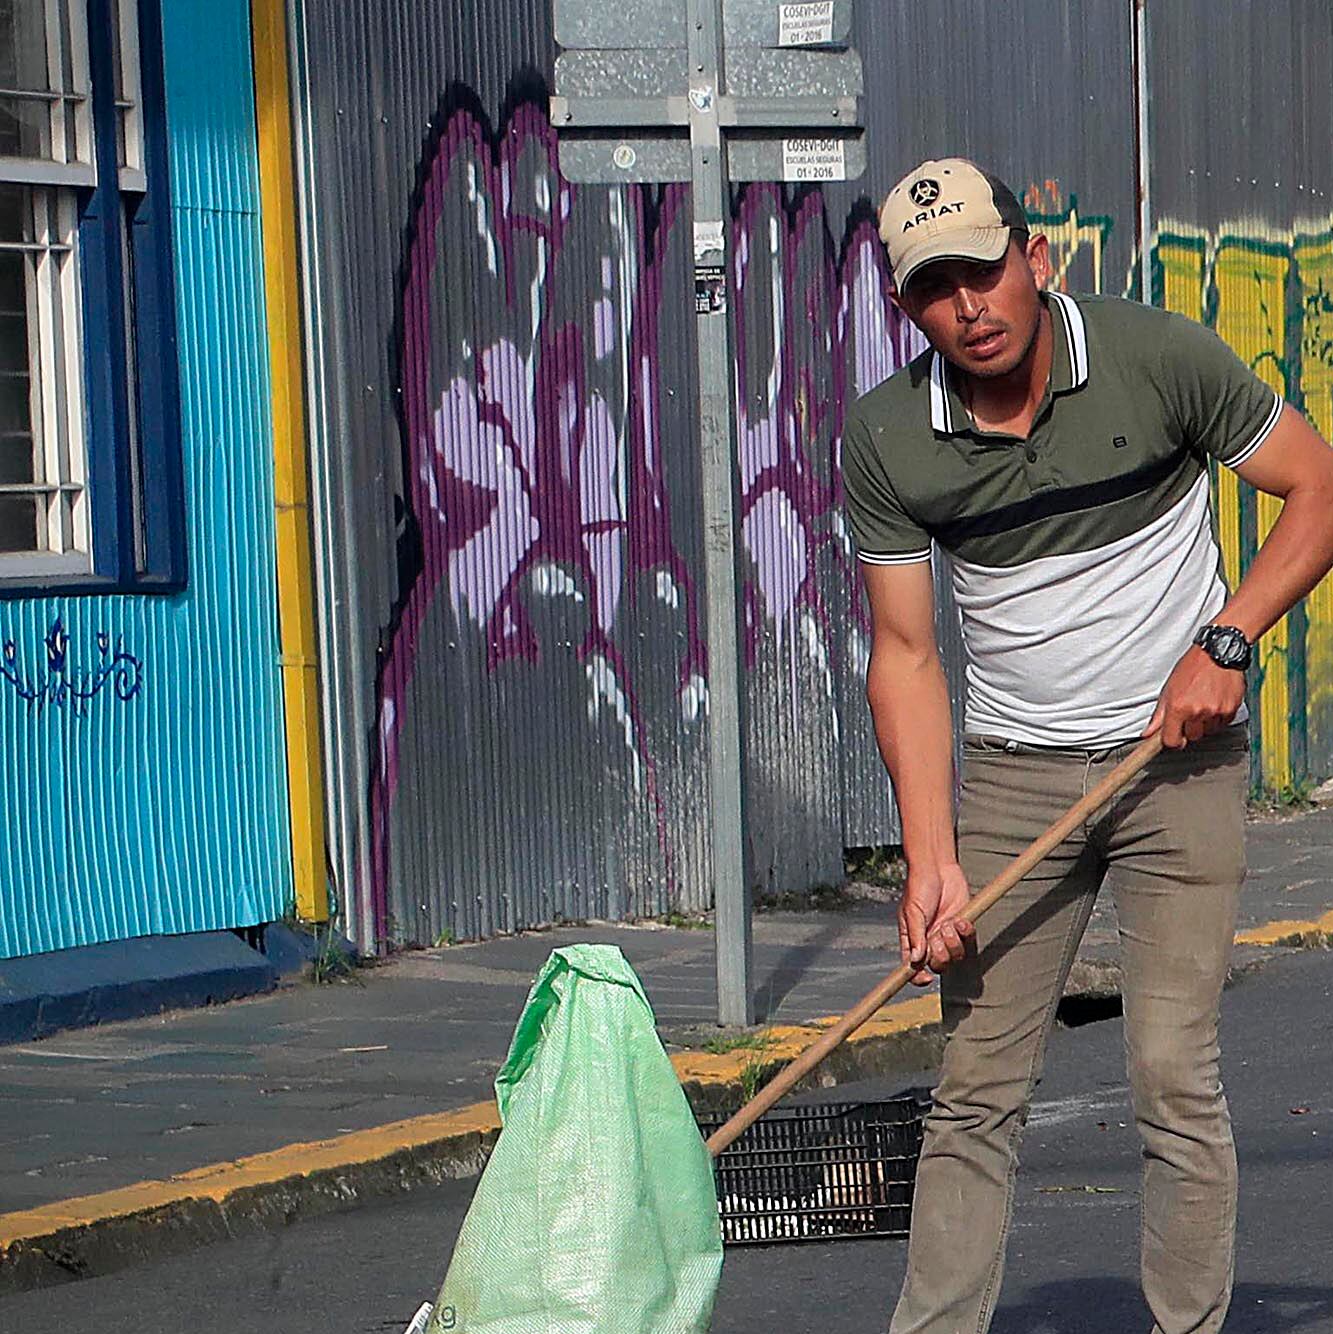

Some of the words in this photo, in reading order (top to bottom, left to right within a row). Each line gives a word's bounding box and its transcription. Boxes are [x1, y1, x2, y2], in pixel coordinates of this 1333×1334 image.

[783, 2, 830, 18] COSEVI-DGIT
[787, 138, 839, 152] COSEVI-DGIT
[786, 156, 815, 164] ESCUELAS
[815, 155, 843, 164] SEGURAS
[903, 202, 964, 233] ARIAT
